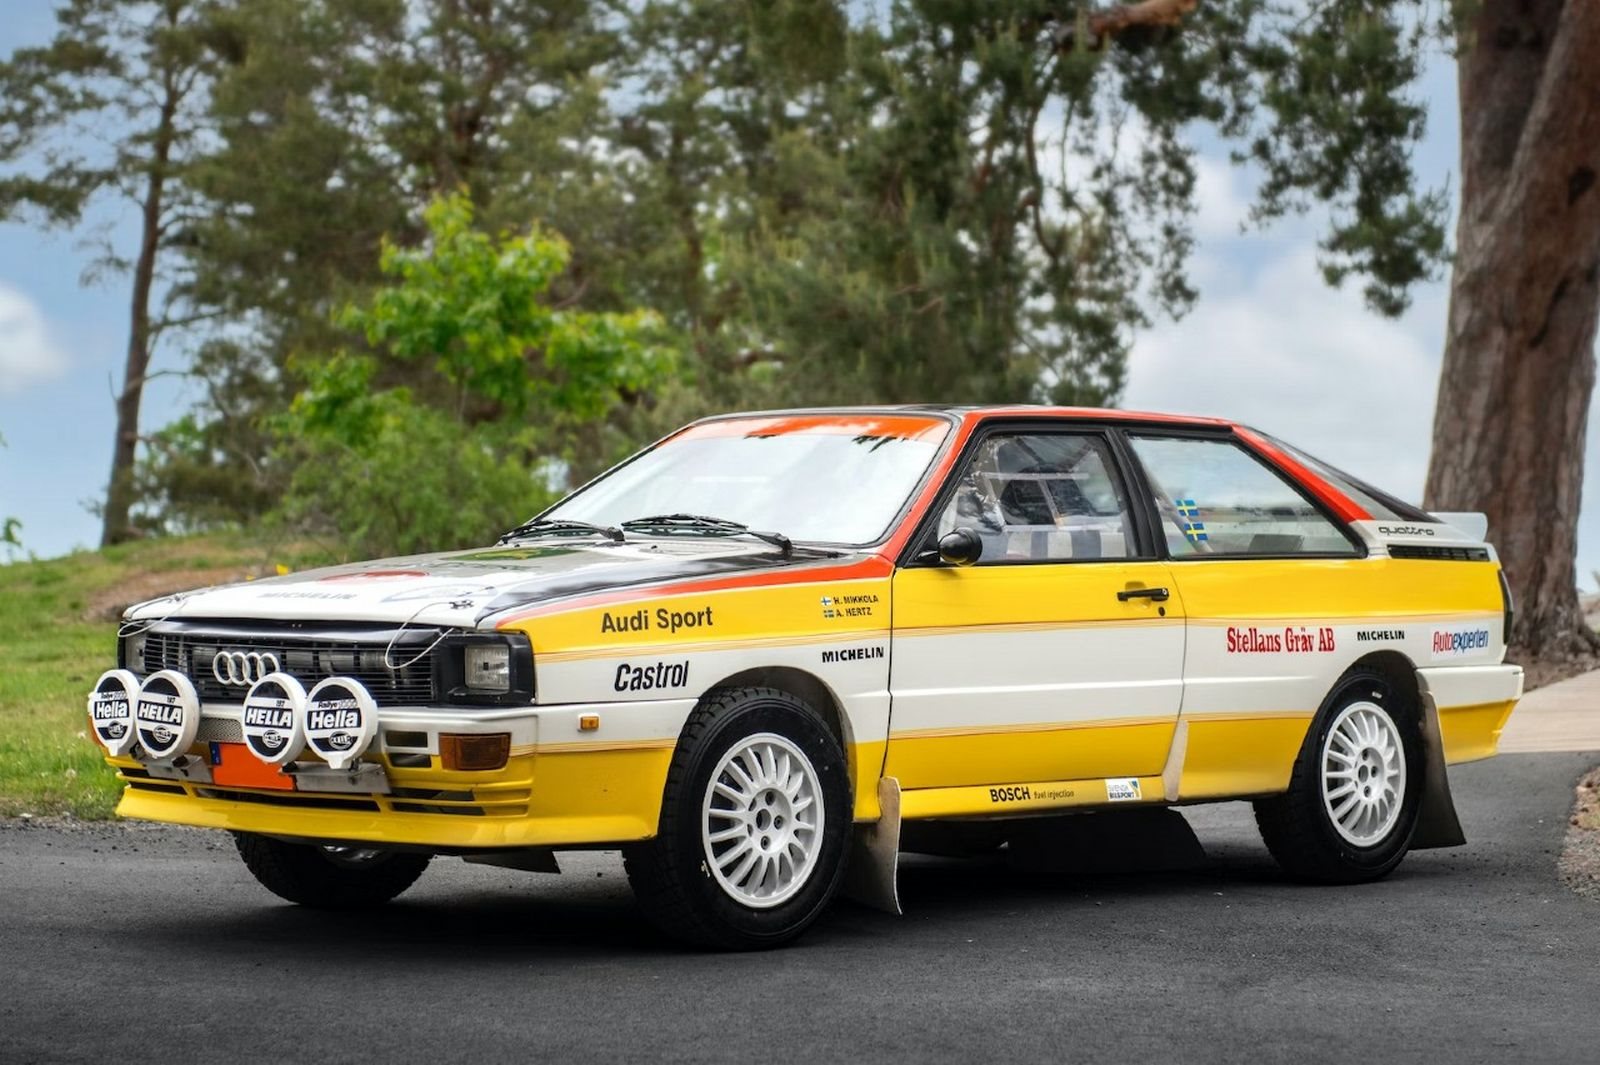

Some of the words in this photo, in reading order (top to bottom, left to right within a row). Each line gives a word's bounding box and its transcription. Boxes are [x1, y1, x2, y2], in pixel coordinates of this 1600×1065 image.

[1378, 526, 1435, 535] quattro
[601, 612, 649, 633] Audi
[657, 606, 713, 633] Sport
[836, 609, 844, 617] A.
[846, 607, 872, 616] HERTZ
[1227, 627, 1281, 652] Stellans
[1285, 627, 1314, 652] Gräv
[1319, 628, 1335, 652] AB
[1357, 630, 1405, 641] MICHELIN
[1433, 629, 1488, 653] Autoexperten
[822, 647, 884, 663] MICHELIN
[614, 661, 689, 692] Castrol
[96, 701, 128, 718] Hella
[139, 702, 182, 723] HELLA
[246, 708, 291, 727] HELLA
[310, 710, 358, 729] Hella
[990, 787, 1031, 802] BOSCH
[1034, 791, 1046, 799] fuel
[1048, 790, 1074, 799] injection
